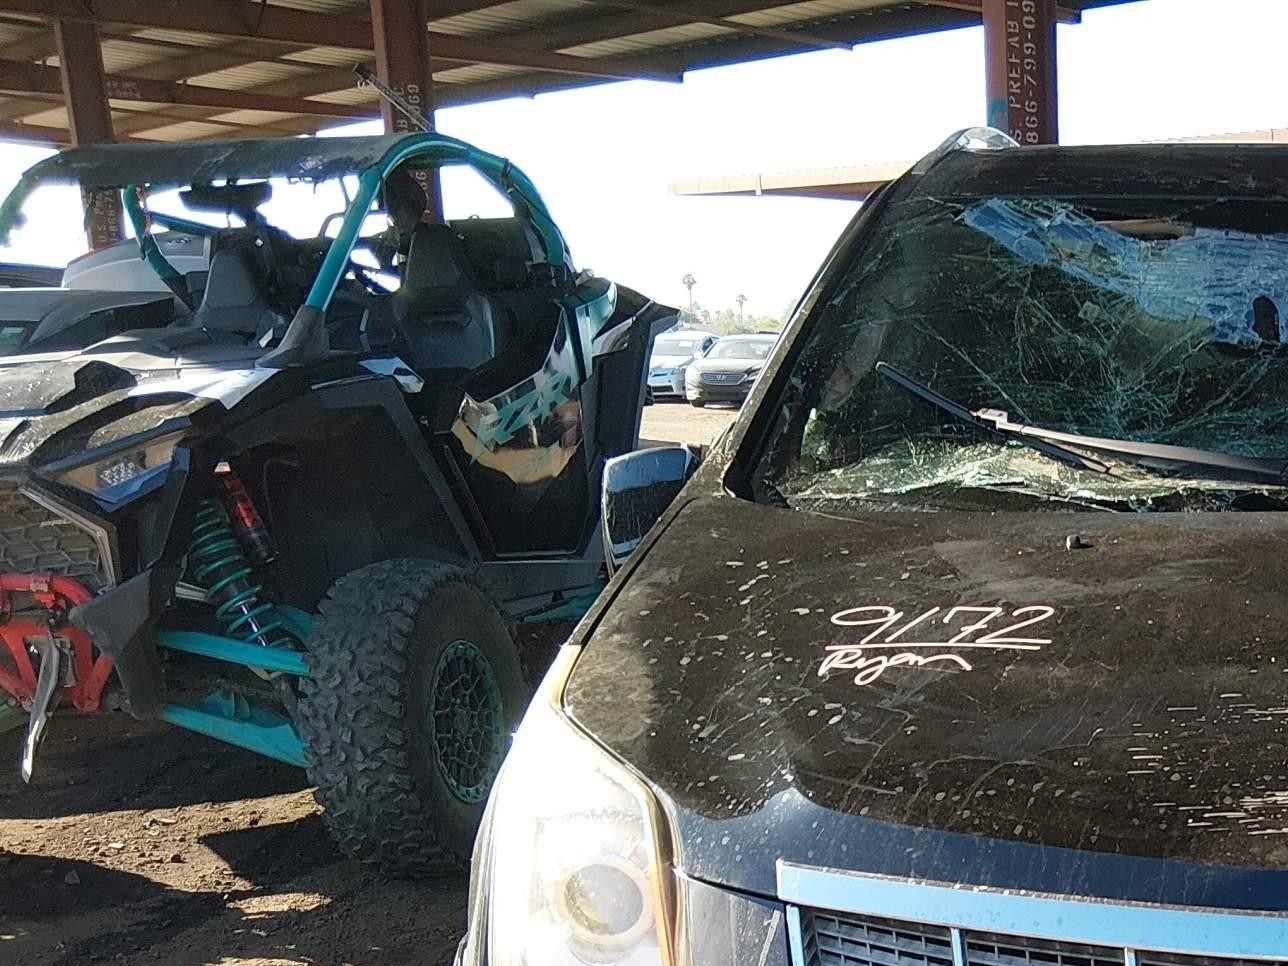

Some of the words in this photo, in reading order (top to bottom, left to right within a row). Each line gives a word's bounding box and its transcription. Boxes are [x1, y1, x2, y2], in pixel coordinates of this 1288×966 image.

[1007, 20, 1022, 109] PREFAB
[1022, 0, 1039, 143] 866-799-09
[818, 649, 973, 686] Ryan
